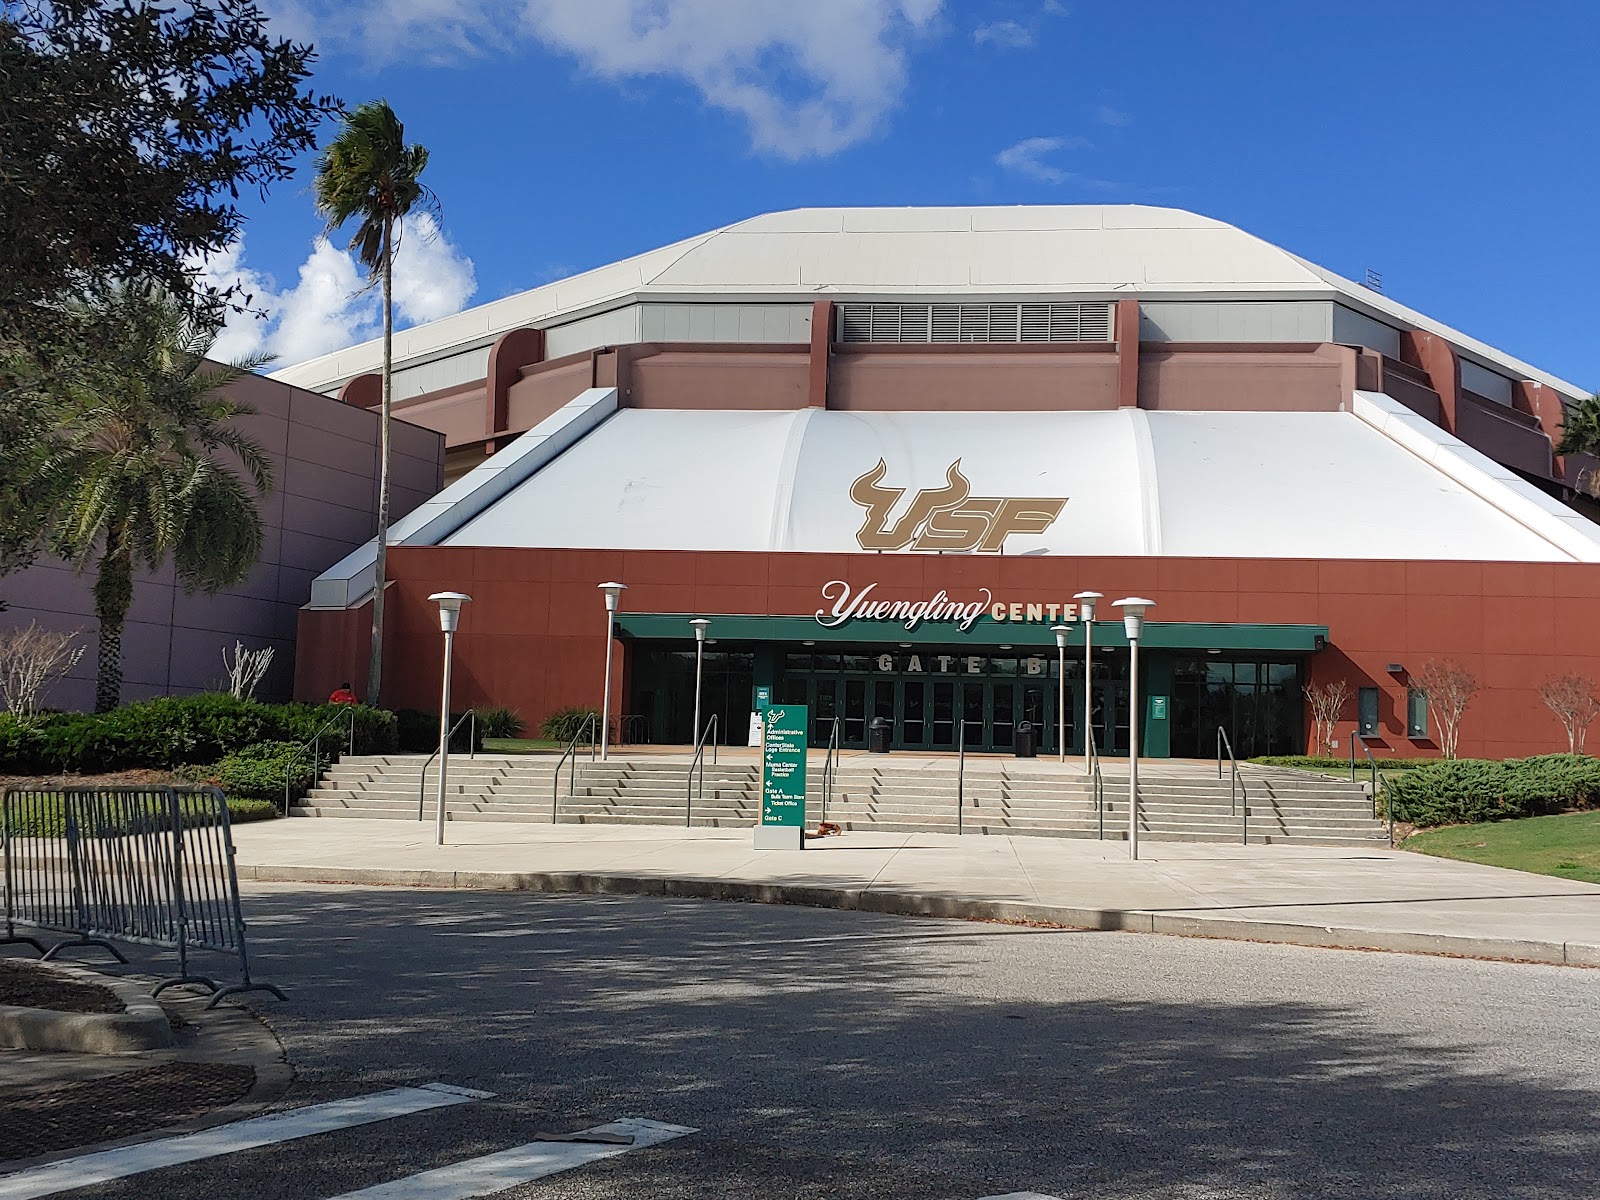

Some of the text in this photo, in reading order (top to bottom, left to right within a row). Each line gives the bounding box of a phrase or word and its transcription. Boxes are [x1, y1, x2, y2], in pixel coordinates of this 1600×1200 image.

[849, 456, 1070, 552] USF
[815, 580, 1096, 631] Yuengling CENTE
[878, 654, 1042, 675] GATE B
